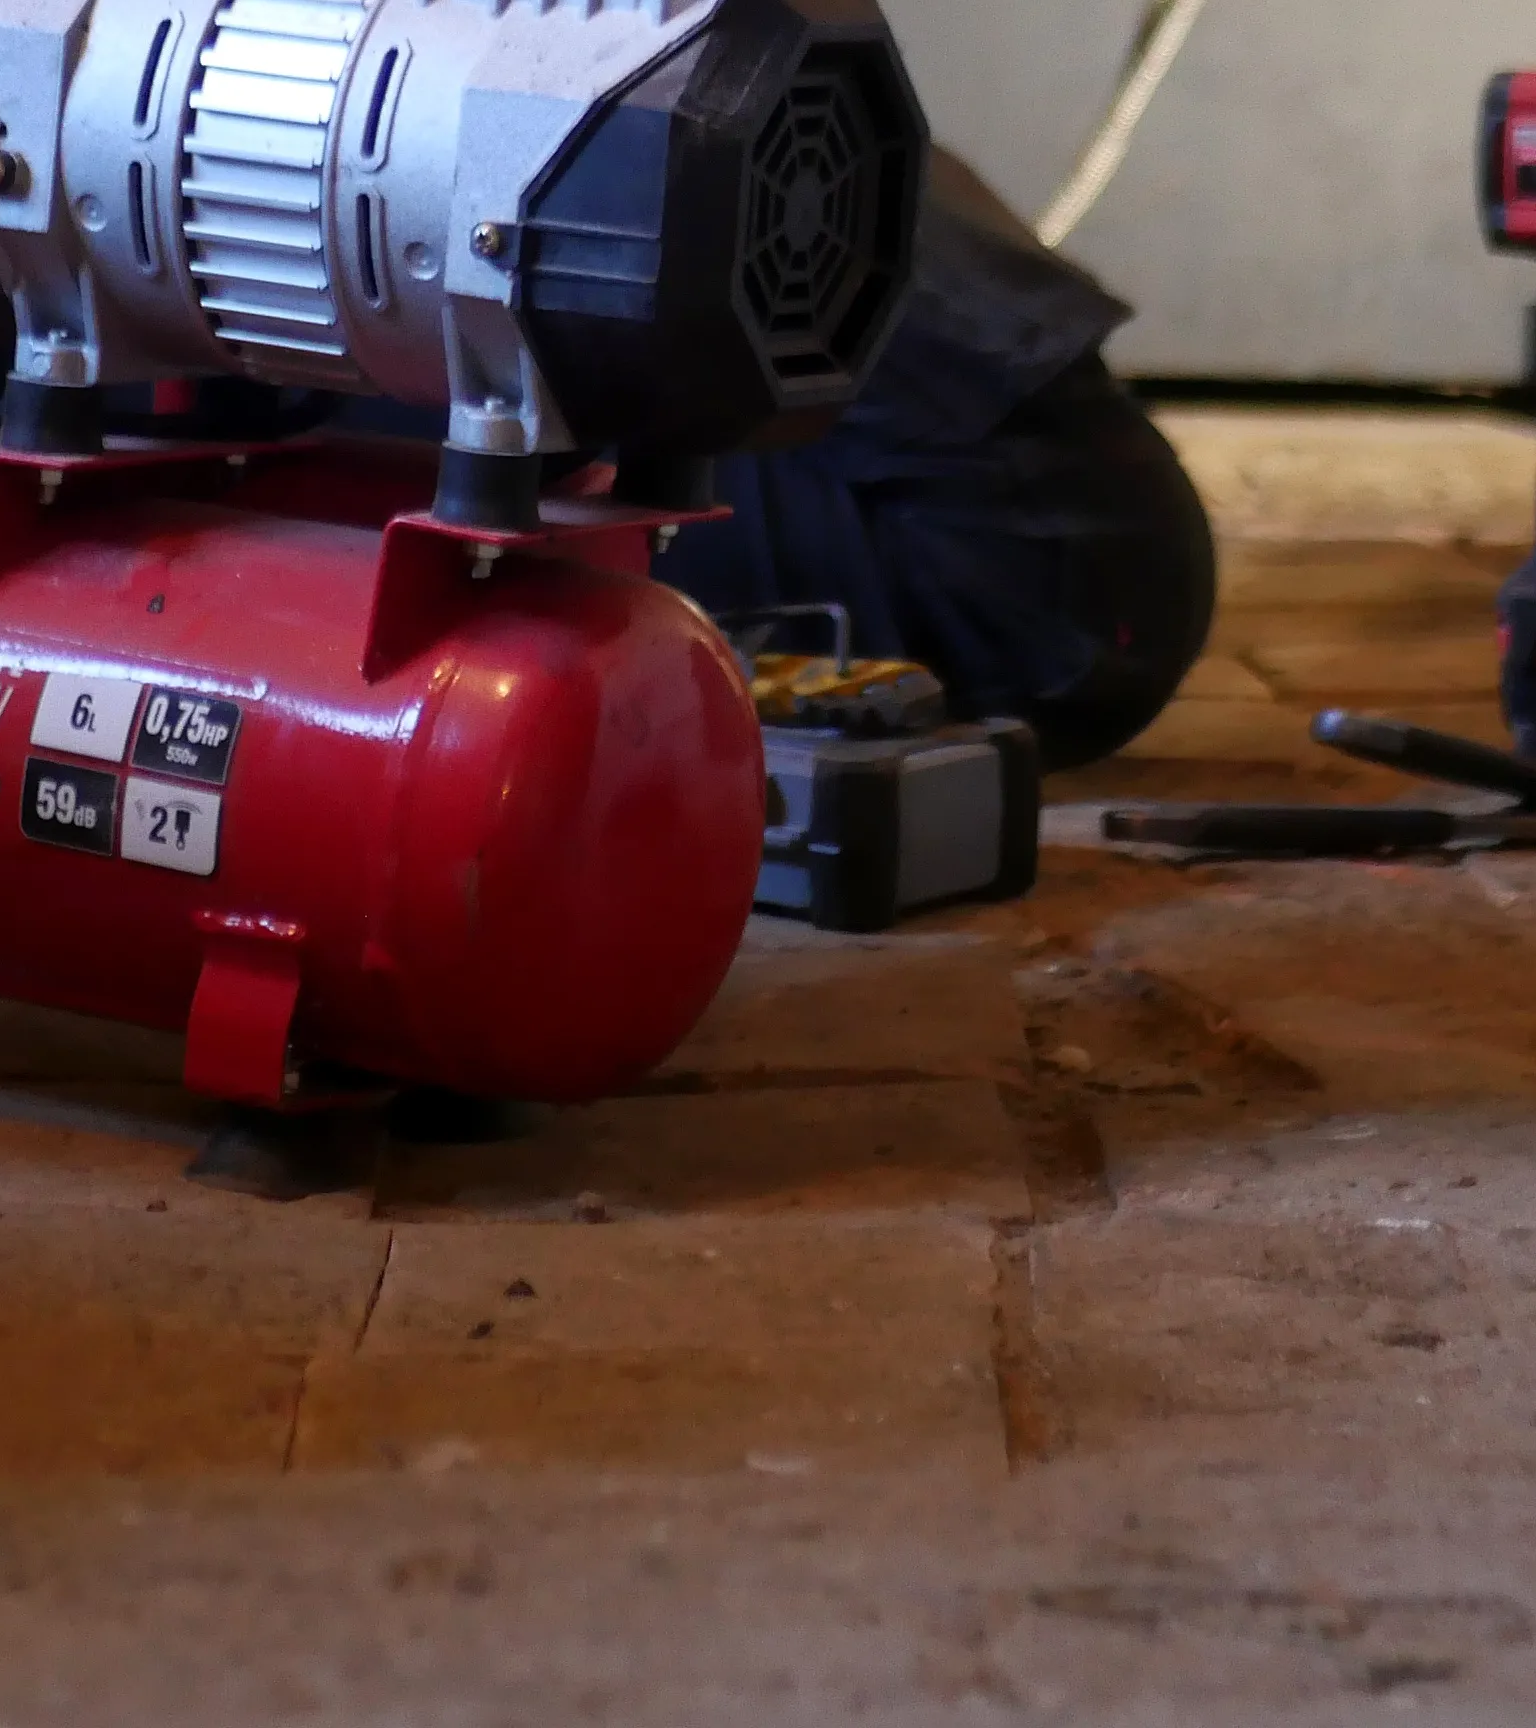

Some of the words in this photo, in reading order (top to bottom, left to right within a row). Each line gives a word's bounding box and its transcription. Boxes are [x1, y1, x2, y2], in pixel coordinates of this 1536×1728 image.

[145, 696, 229, 747] 0,75HP
[35, 777, 98, 830] 59dB
[148, 806, 169, 845] 2
